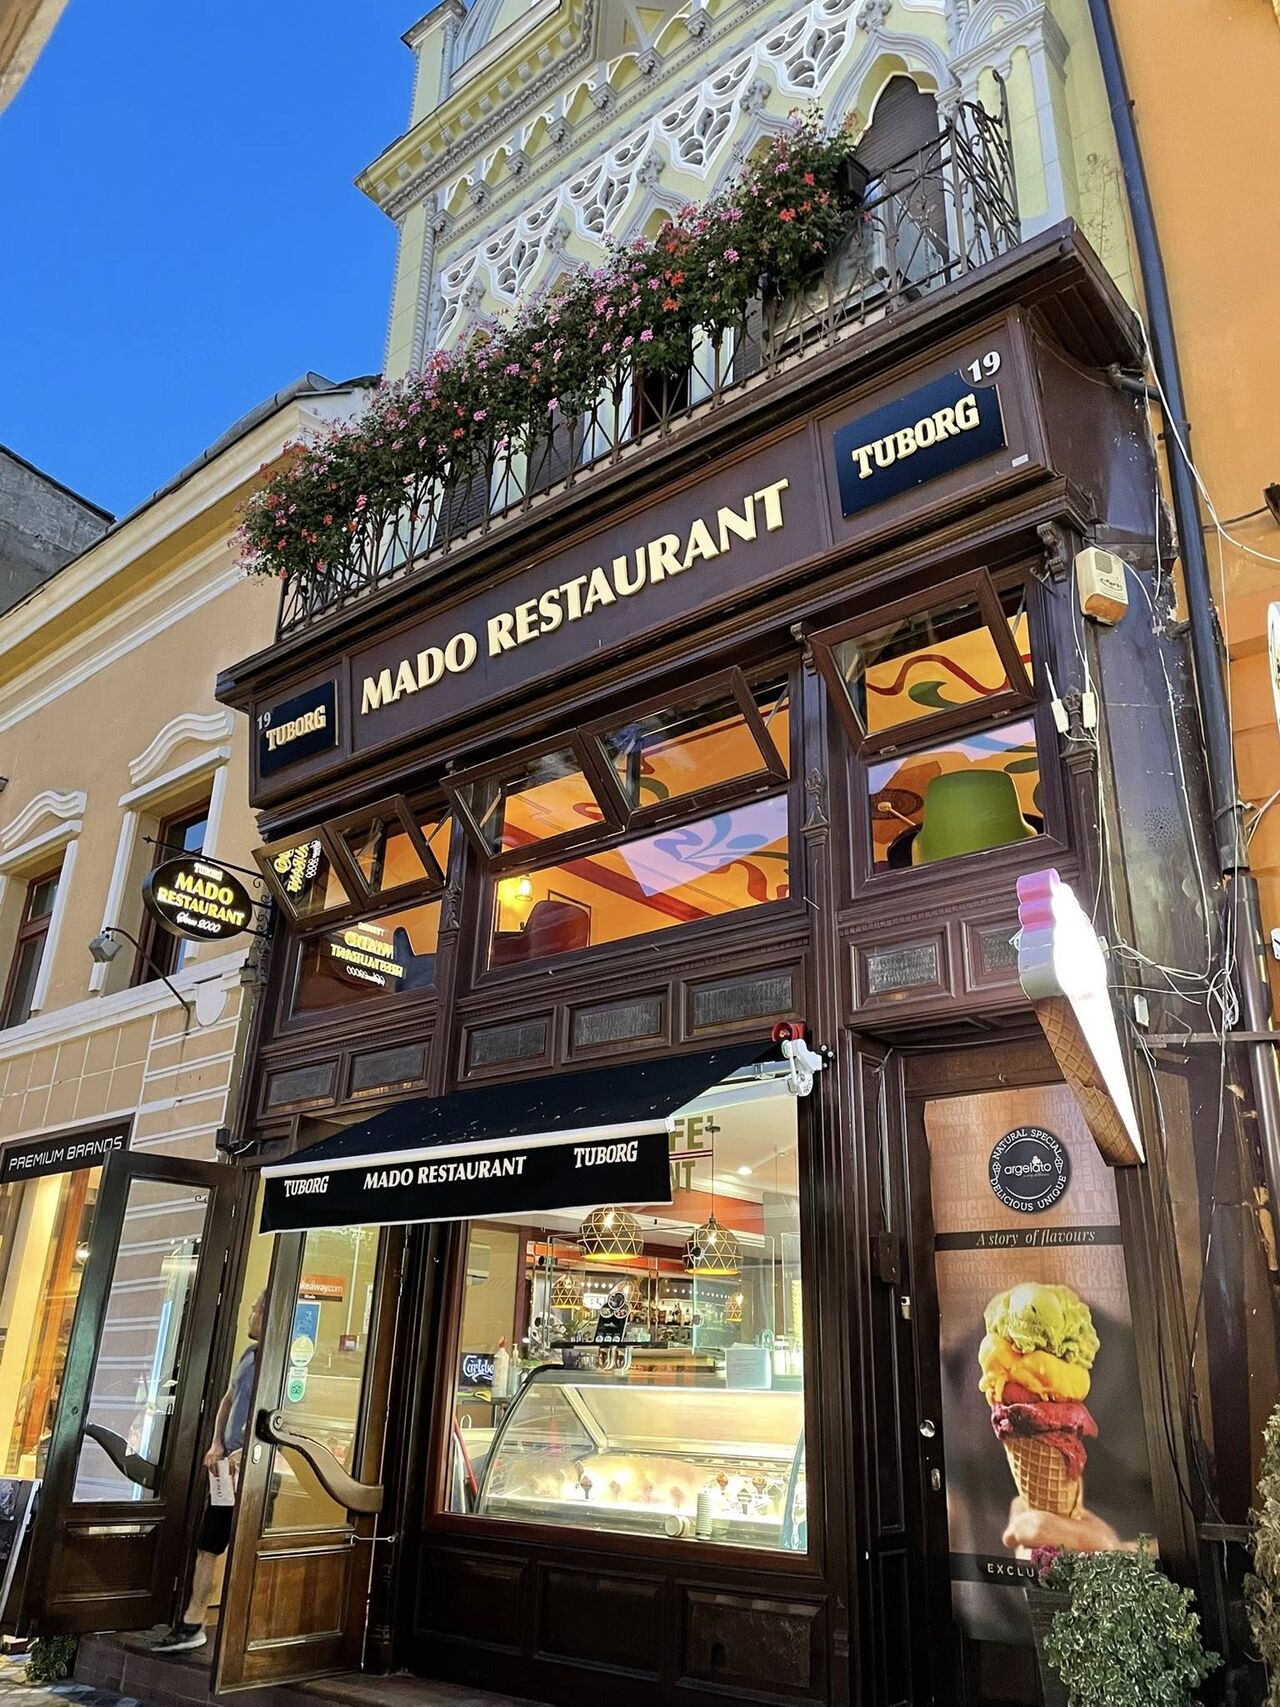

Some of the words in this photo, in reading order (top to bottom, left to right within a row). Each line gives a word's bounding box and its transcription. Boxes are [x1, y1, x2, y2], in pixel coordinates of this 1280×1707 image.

[966, 351, 1001, 383] 19
[851, 393, 980, 480] TUBORG
[360, 632, 477, 714] MADO
[487, 478, 789, 657] RESTAURANT
[257, 711, 272, 730] 19
[266, 704, 327, 752] TUBORG
[174, 872, 234, 906] MADO
[157, 887, 246, 926] RESTAURANT
[8, 1148, 65, 1171] PREMIUM
[66, 1135, 123, 1160] BRANDS
[573, 1140, 639, 1169] TUBORG
[992, 1128, 1028, 1160] NATURAL
[1030, 1129, 1063, 1158] SPECIAL
[283, 1175, 329, 1198] TUBORG
[362, 1168, 414, 1191] MADO
[417, 1156, 527, 1186] RESTAURANT
[1004, 1161, 1052, 1177] argelato
[990, 1178, 1034, 1211] DELICIOUS
[1037, 1174, 1067, 1209] UNIQUE
[976, 1232, 986, 1247] A
[988, 1233, 1018, 1248] story
[1025, 1230, 1039, 1247] of
[1041, 1228, 1096, 1246] flavours
[987, 1563, 1035, 1578] EXCLU
